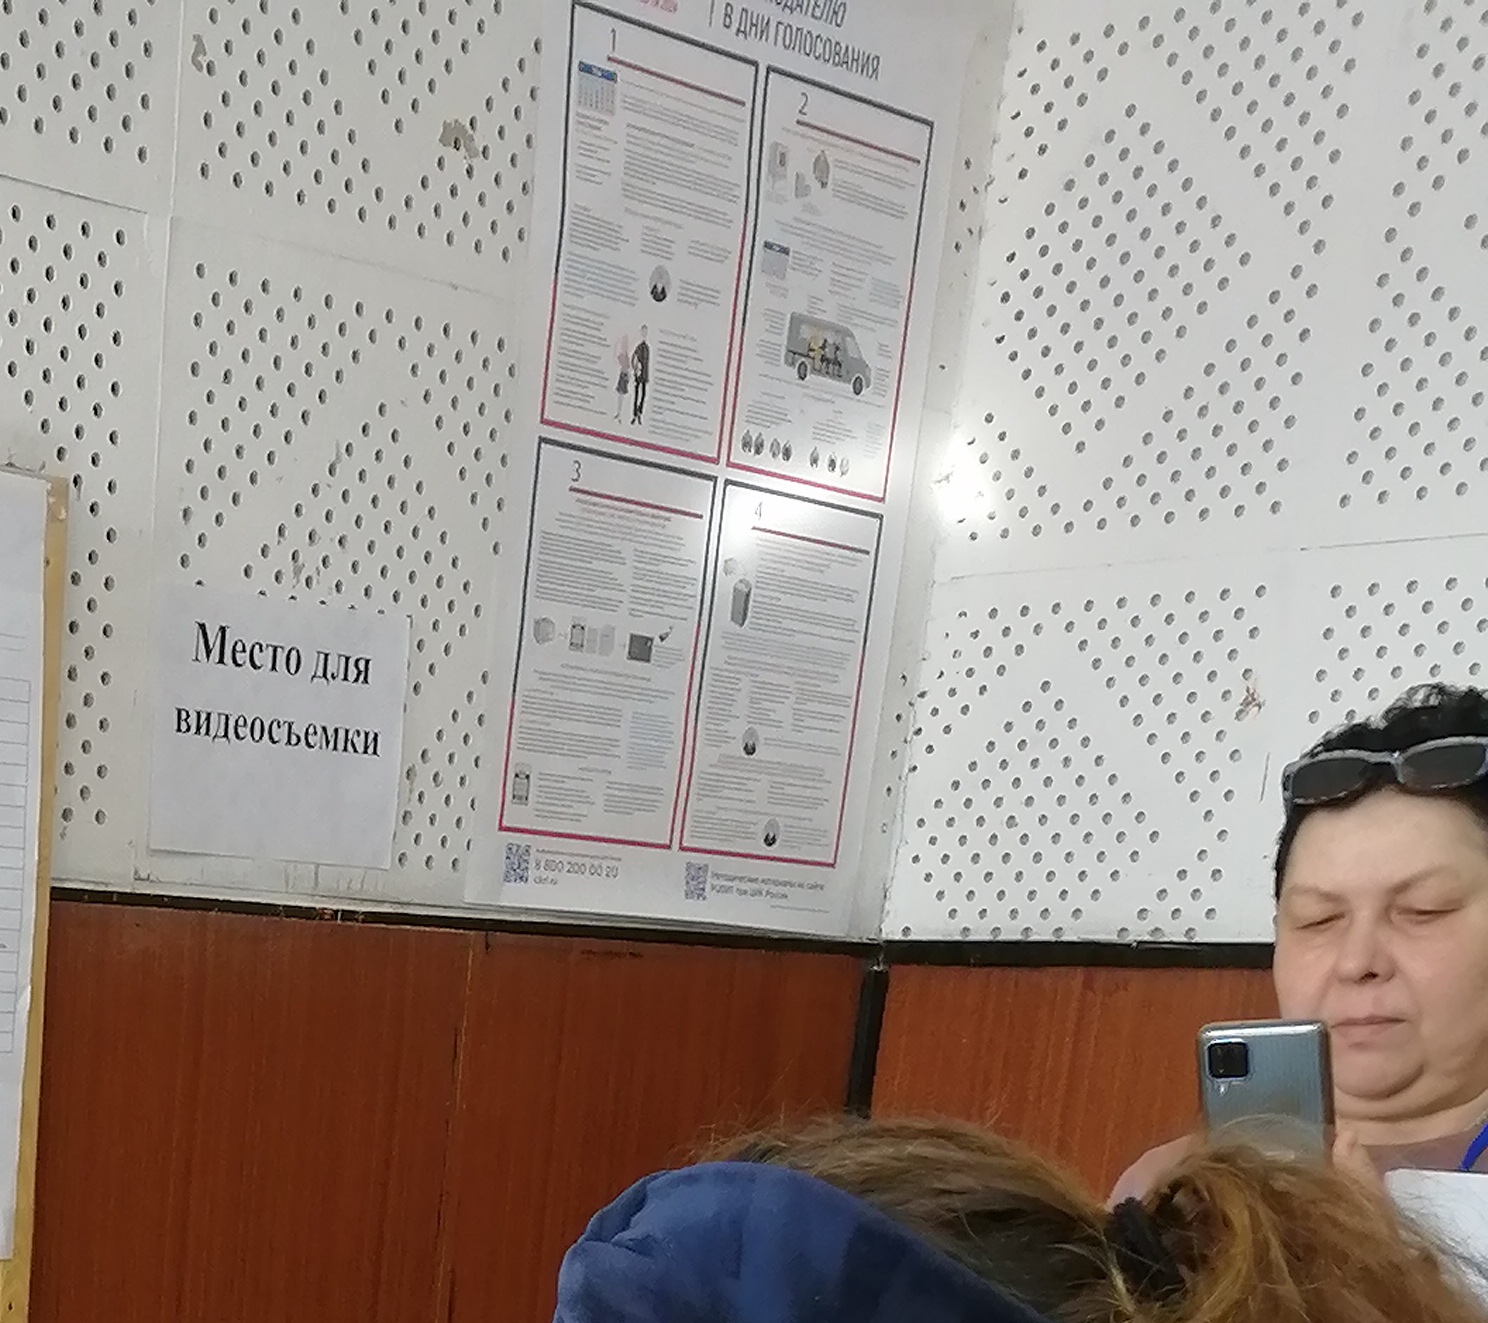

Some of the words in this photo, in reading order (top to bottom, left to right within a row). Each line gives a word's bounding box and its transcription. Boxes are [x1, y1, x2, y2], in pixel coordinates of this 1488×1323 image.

[768, 0, 847, 28] ДАТЕЛЮ
[723, 2, 733, 29] В
[735, 8, 770, 44] ДНИ
[773, 21, 881, 82] ГОЛОСОВАНИЯ
[798, 92, 809, 116] 2
[570, 459, 581, 483] 3
[192, 620, 303, 676] Место
[309, 649, 373, 685] для
[174, 706, 382, 758] видеосъемки
